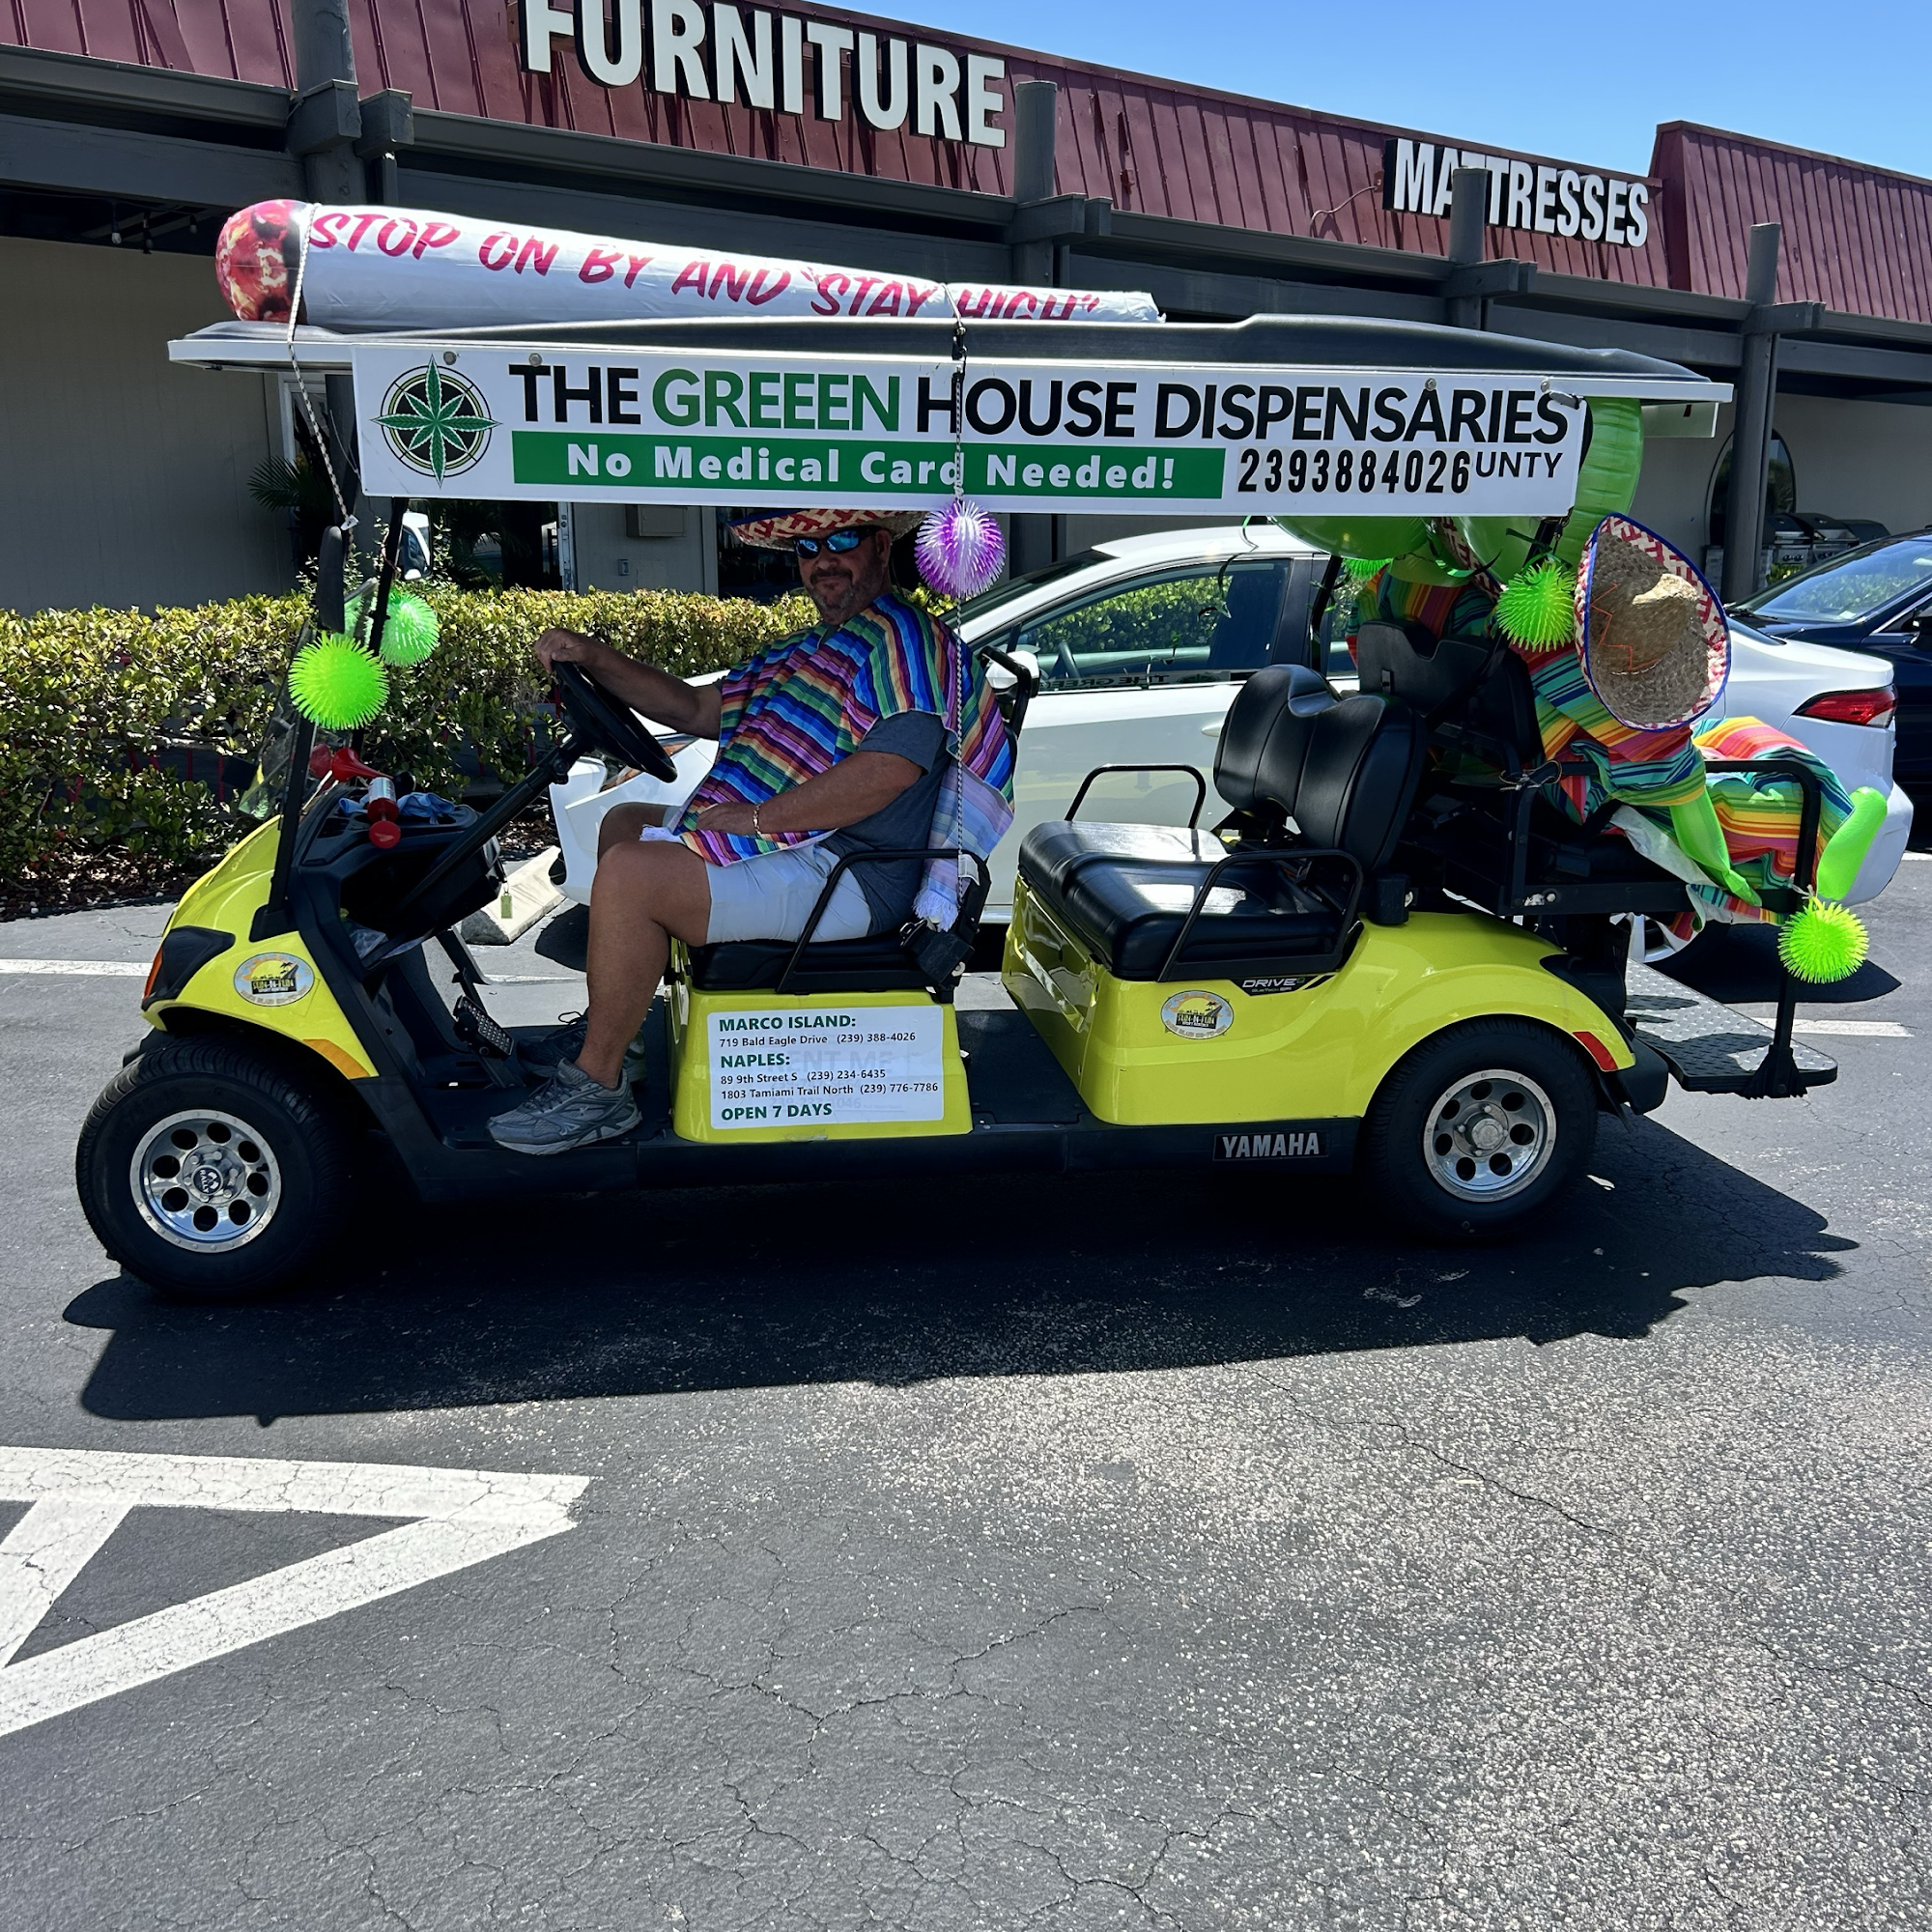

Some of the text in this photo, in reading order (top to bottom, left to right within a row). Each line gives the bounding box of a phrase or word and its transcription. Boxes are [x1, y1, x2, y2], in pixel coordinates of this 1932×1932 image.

[525, 0, 1007, 148] FURNITURE
[309, 213, 461, 260] STOP
[478, 231, 559, 276] ON
[578, 244, 654, 289] BY
[671, 259, 791, 306] AND
[509, 364, 1568, 444] THE GREEEN HOUSE DISPENSARIES
[567, 443, 1175, 490] No Medical Card Needed!
[1237, 448, 1471, 494] 2393884026
[719, 1015, 856, 1032] MARCO ISLAND:
[720, 1032, 916, 1047] 719 Bald Eagle Drive (239) 388-4026
[721, 1053, 790, 1067] NAPLES:
[721, 1069, 886, 1085] 89 9th Street S (239) 234-6435
[722, 1090, 746, 1099] 1803
[750, 1087, 794, 1097] Tamiami
[797, 1086, 819, 1095] Trail
[823, 1085, 854, 1094] North
[860, 1084, 887, 1094] (239)
[890, 1083, 938, 1093] 776-7786
[722, 1103, 833, 1121] OPEN 7 DAYS
[1222, 1132, 1320, 1158] YAMAHA
